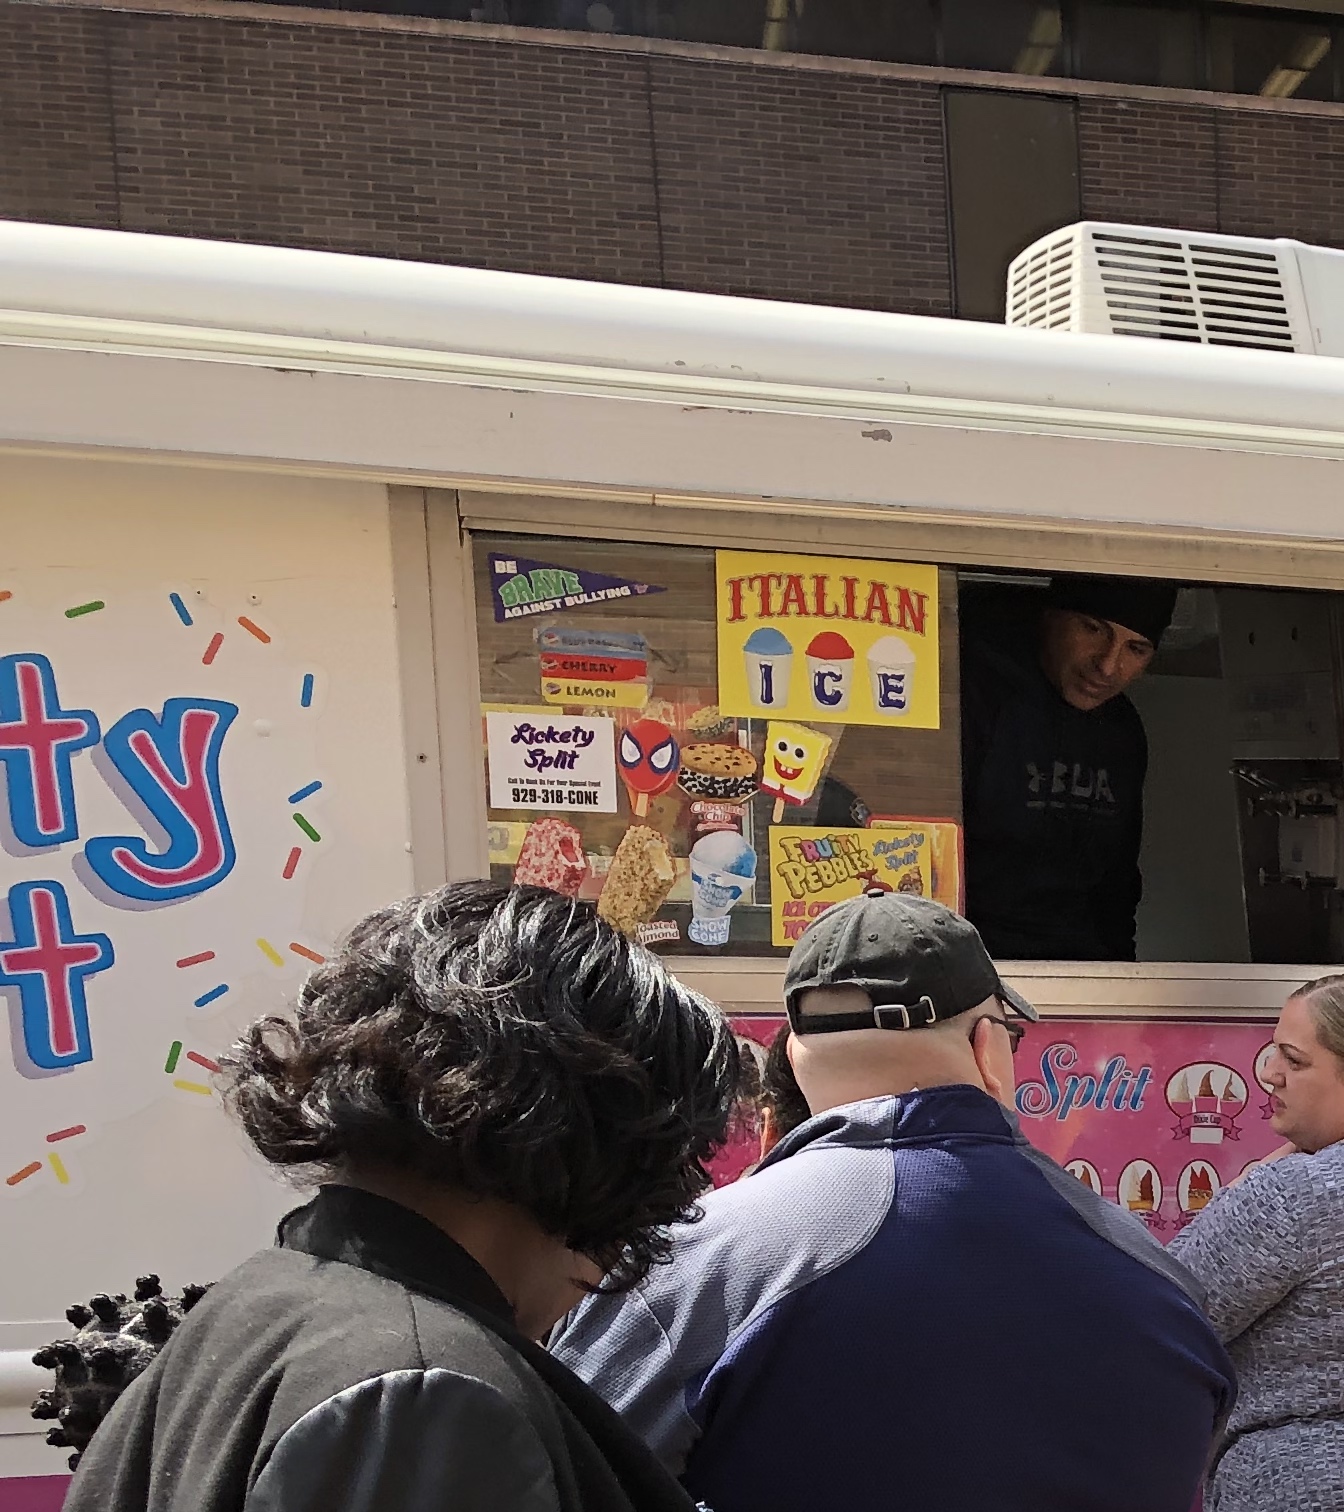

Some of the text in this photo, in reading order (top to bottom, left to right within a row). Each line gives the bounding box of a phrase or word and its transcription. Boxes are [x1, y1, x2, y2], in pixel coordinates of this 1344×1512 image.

[494, 561, 518, 574] BE
[498, 568, 584, 608] BRAVE
[504, 585, 632, 619] AGAINST BULLYING
[726, 572, 930, 638] ITALIAN
[561, 661, 617, 674] CHERRY
[566, 685, 616, 698] LEMON
[510, 722, 595, 748] Lickety
[524, 748, 580, 773] Split
[511, 787, 599, 806] 929-318-CONE
[690, 801, 747, 816] Chocolate
[703, 811, 731, 823] Chip
[776, 849, 875, 899] PEBBLES
[635, 919, 677, 933] Toasted
[692, 917, 730, 933] SNOW
[1015, 1043, 1154, 1122] Split
